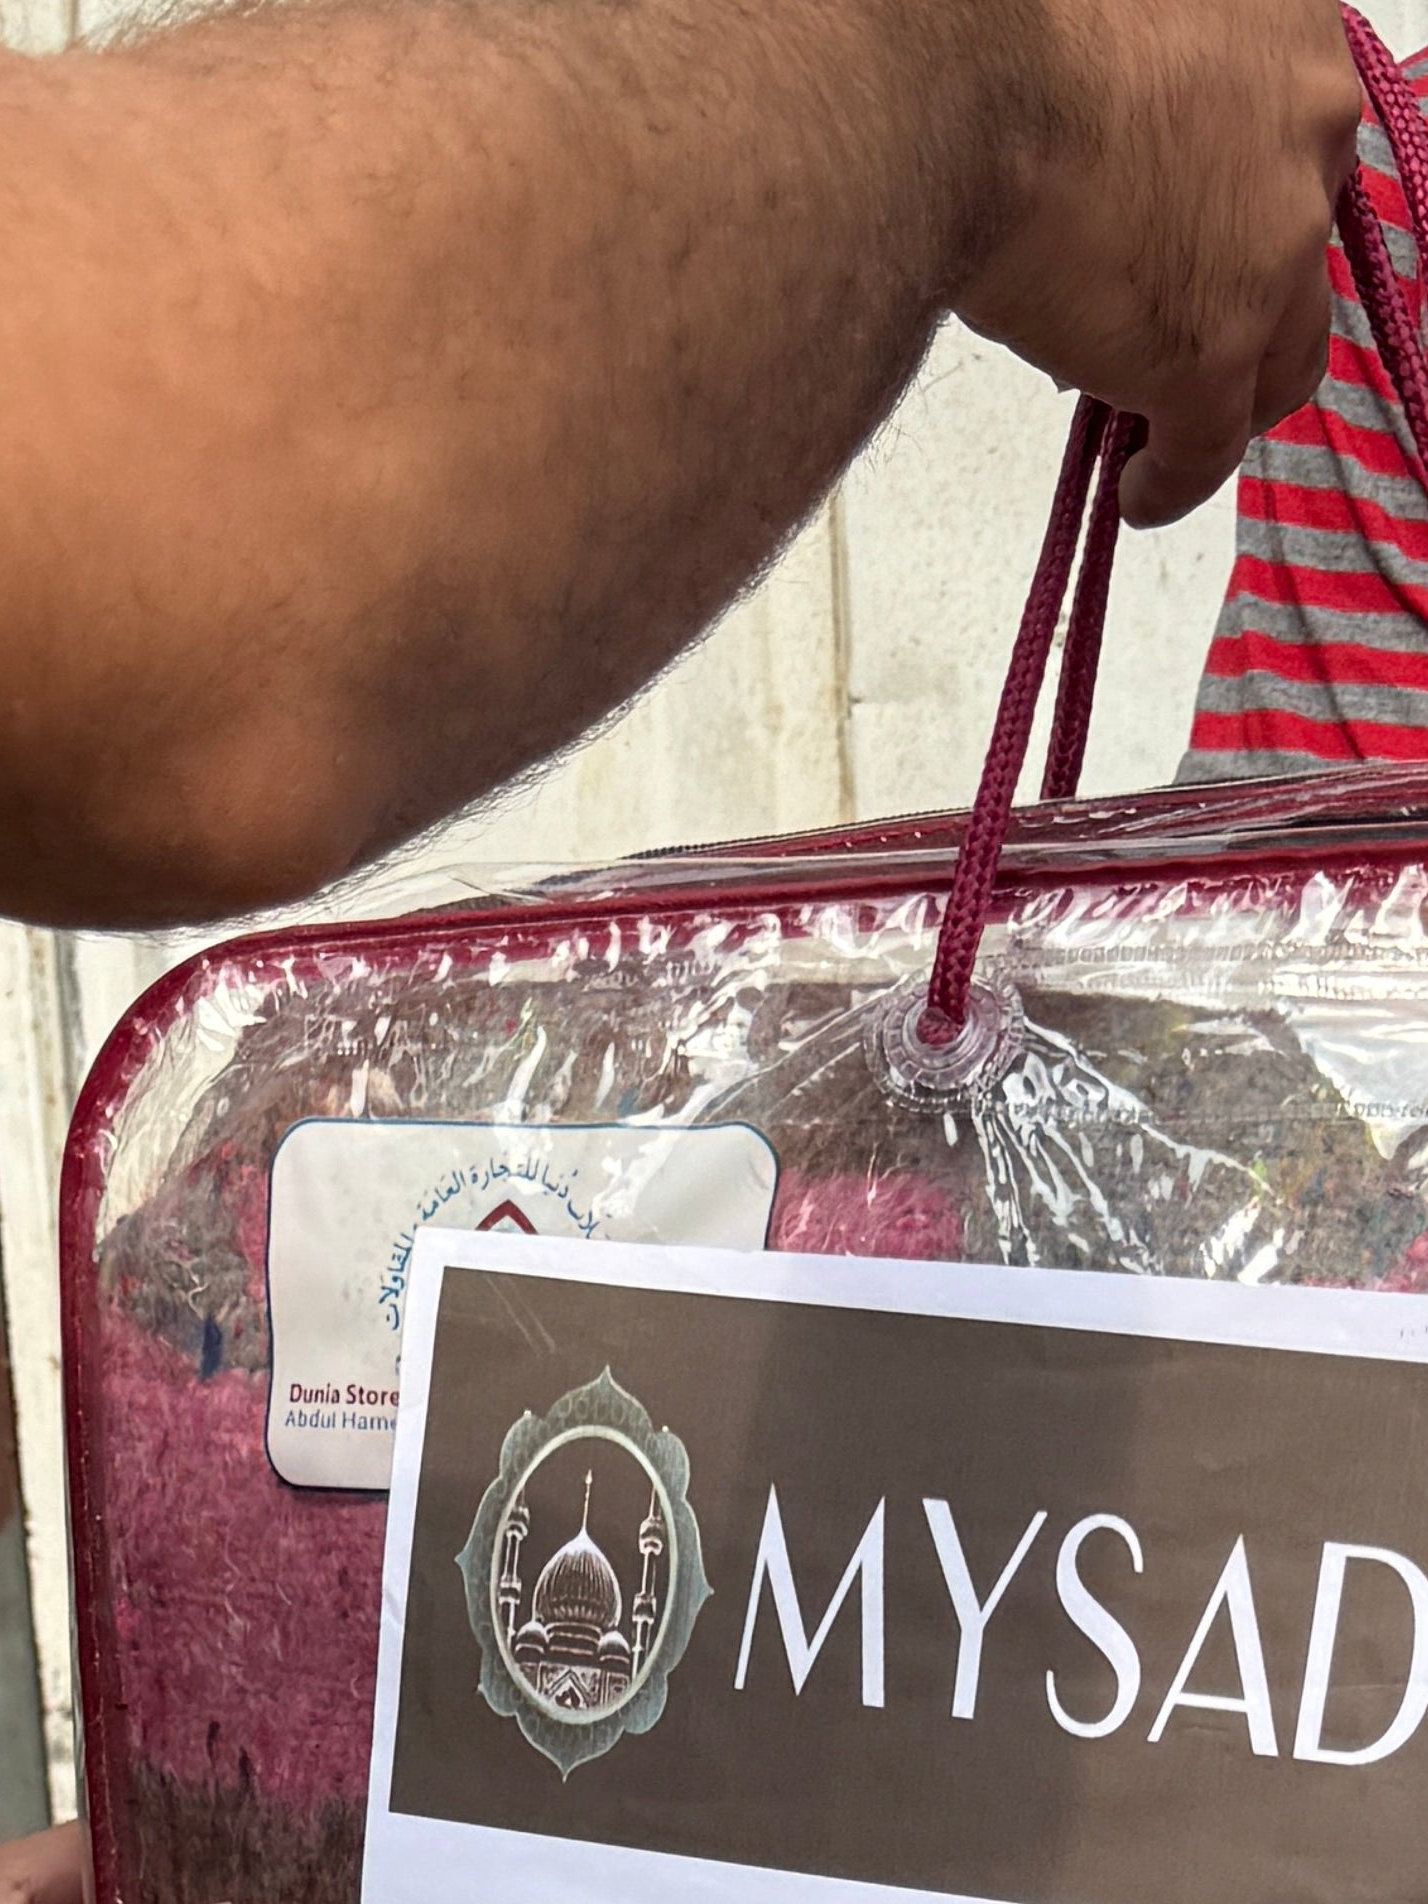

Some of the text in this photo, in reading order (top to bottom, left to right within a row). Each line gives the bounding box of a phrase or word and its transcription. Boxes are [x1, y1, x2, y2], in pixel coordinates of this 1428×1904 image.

[289, 1382, 400, 1408] Dunia Store
[284, 1408, 336, 1429] Abdul
